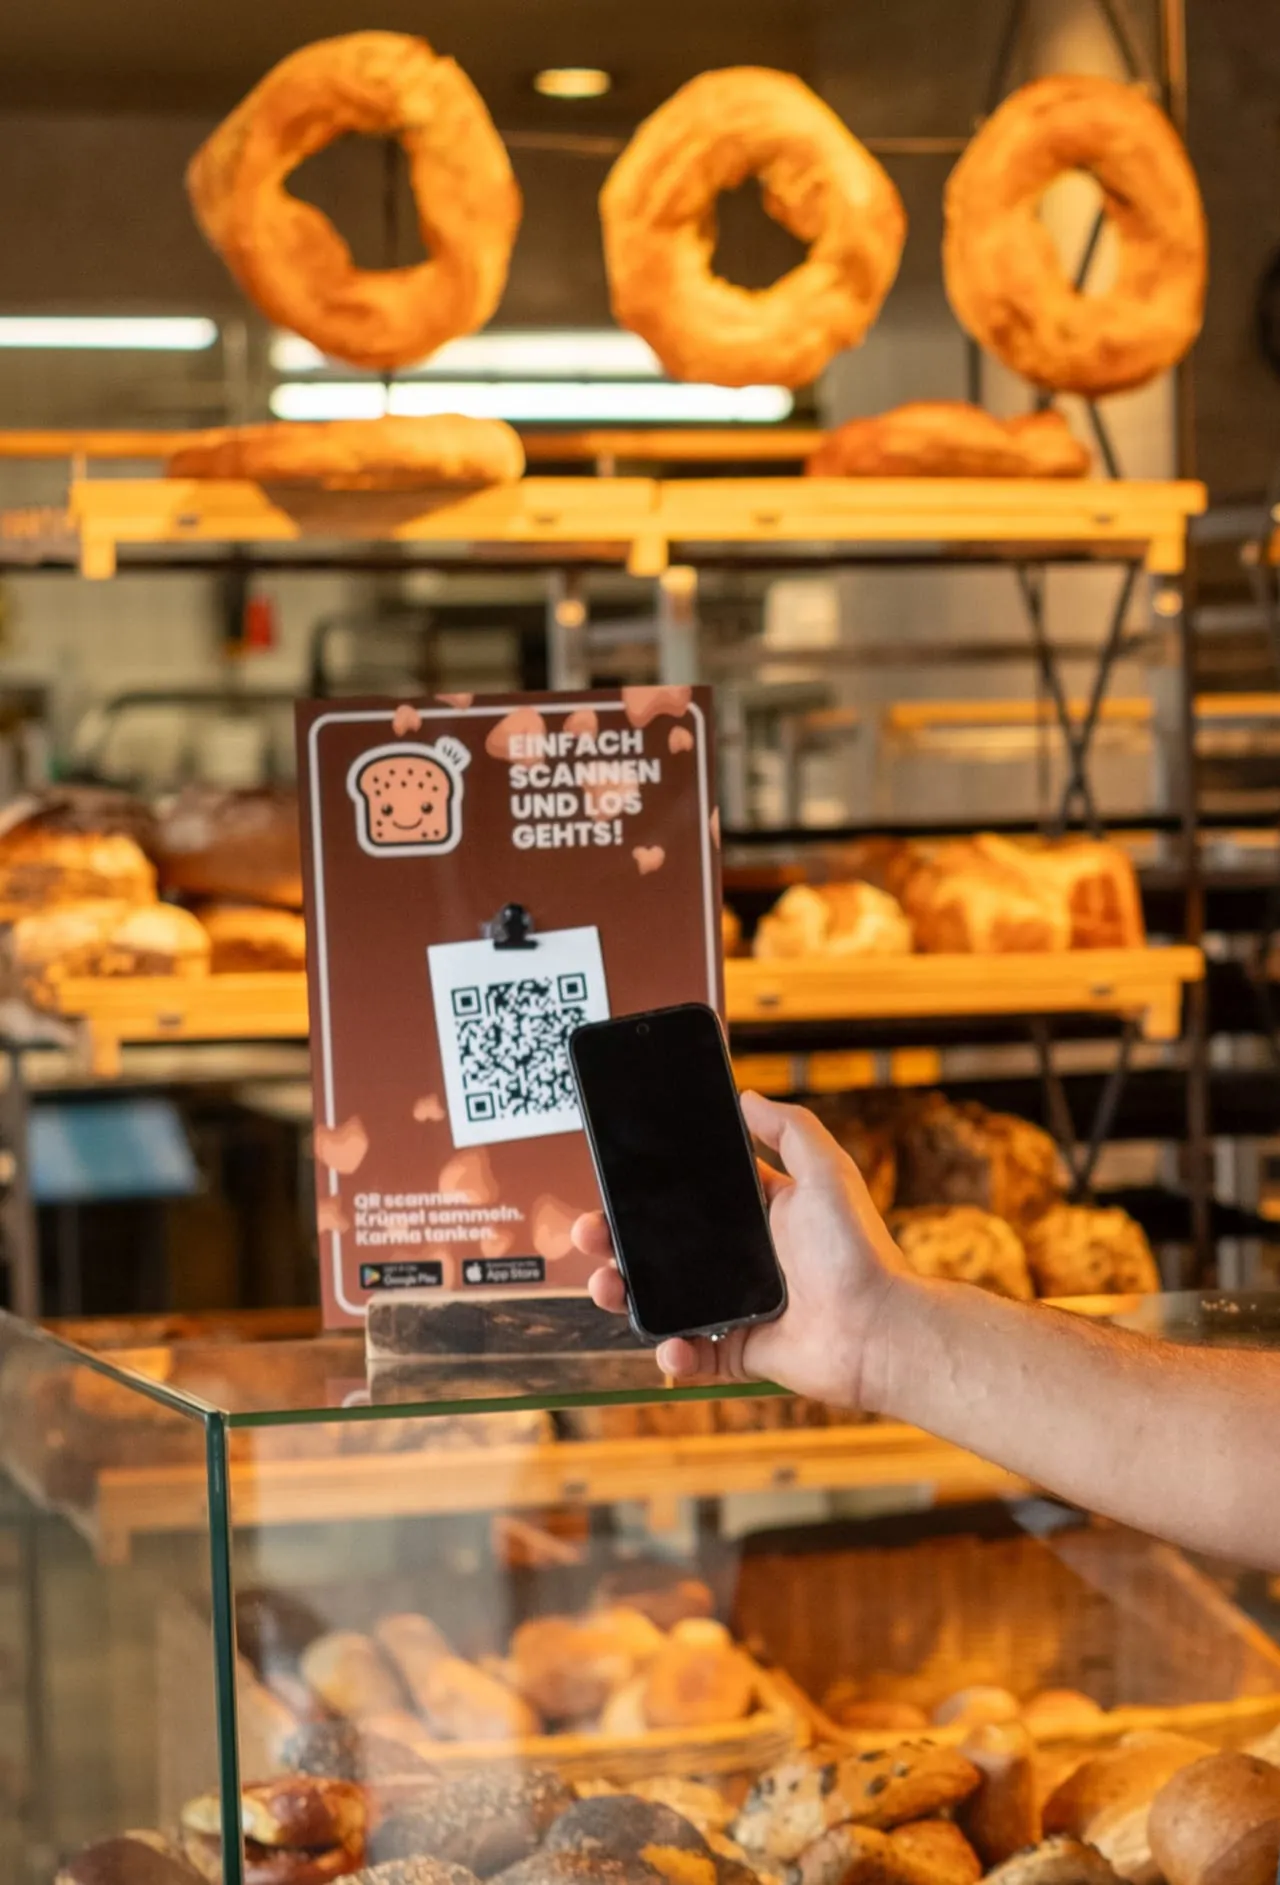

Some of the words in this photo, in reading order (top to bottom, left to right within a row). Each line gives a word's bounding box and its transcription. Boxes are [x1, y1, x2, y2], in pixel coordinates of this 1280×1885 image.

[509, 729, 644, 760] EINFACH
[509, 758, 661, 789] SCANNEN
[510, 791, 579, 819] UND
[584, 789, 643, 817] LOS
[512, 819, 624, 849] GEHTS!
[354, 1192, 381, 1210] QR
[354, 1208, 425, 1227] Krümel
[428, 1205, 525, 1224] sammeln.
[355, 1228, 422, 1246] Karma
[424, 1225, 497, 1243] tanken.
